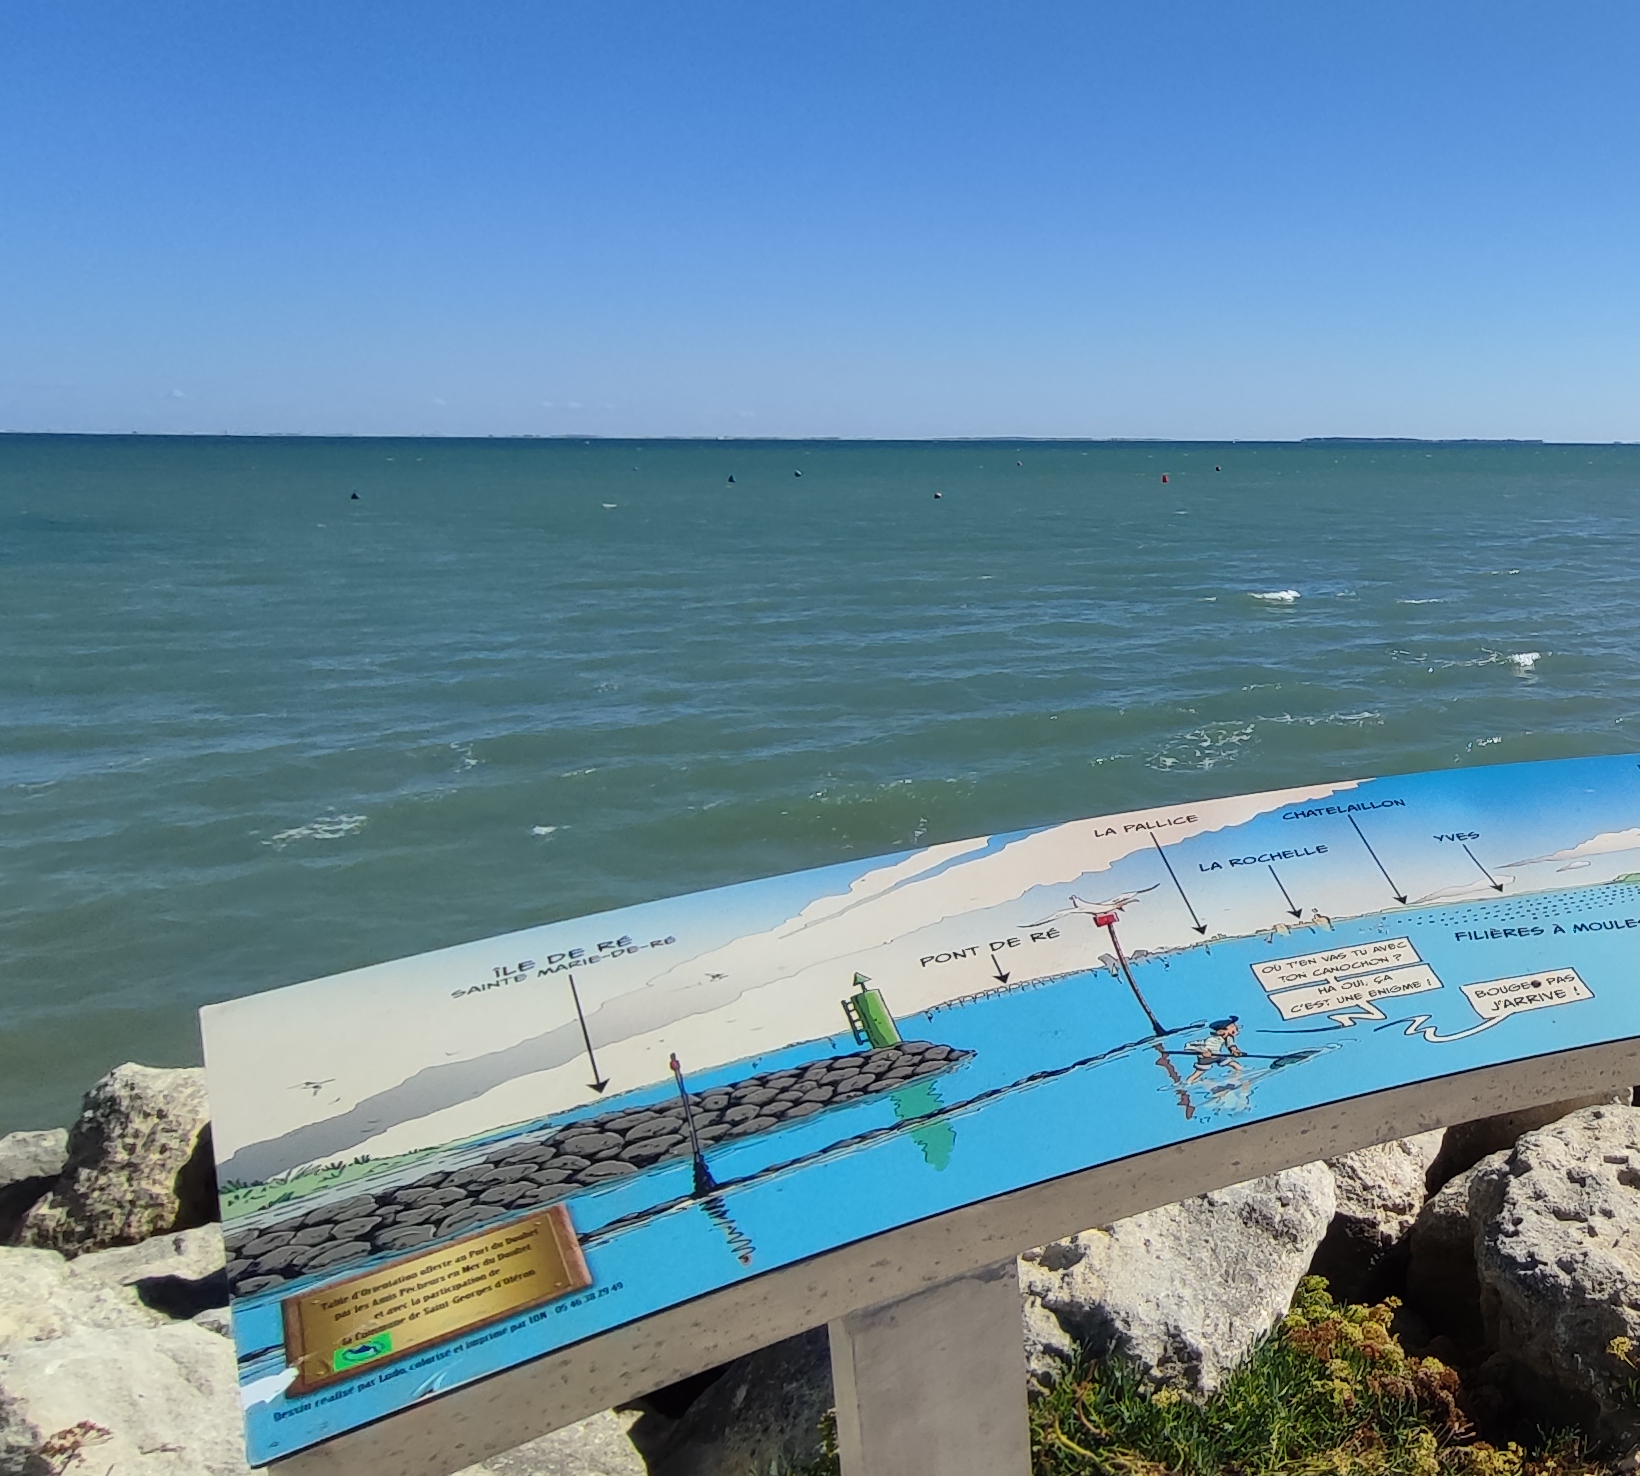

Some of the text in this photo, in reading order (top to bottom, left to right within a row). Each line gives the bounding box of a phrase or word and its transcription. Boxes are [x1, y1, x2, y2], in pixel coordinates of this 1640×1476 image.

[1282, 798, 1406, 820] CHATELAILLON
[1094, 813, 1199, 838] LA PALLICE
[1432, 831, 1480, 843] YVES
[1199, 844, 1329, 873] LA ROCHELLE
[1454, 925, 1545, 942] FILIÈRES
[1552, 923, 1566, 935] À
[492, 934, 633, 979] ÎLE DE RÉ
[919, 928, 1061, 968] PONT DE RÉ
[1286, 957, 1317, 969] T'EN
[1321, 952, 1347, 963] VAS
[1350, 948, 1368, 958] TU
[1373, 941, 1408, 954] AVEC
[450, 936, 677, 999] SAINTE MARIE-DE-RÉ
[1278, 953, 1402, 983] TON CANOCHON ?
[1290, 999, 1331, 1014] C'EST
[1336, 992, 1363, 1004] UNE
[1368, 981, 1422, 998] ENIGME
[1317, 985, 1337, 995] HA
[1373, 974, 1393, 985] ÇA
[1475, 974, 1575, 999] BOUGE PAS
[1491, 986, 1580, 1011] J'ARRIVE !
[455, 1253, 467, 1263] au
[469, 1245, 490, 1259] Port
[491, 1240, 504, 1250] du
[333, 1307, 351, 1321] par
[354, 1301, 370, 1314] les
[372, 1291, 397, 1306] Amis
[447, 1269, 460, 1280] en
[462, 1261, 481, 1274] Mer
[483, 1256, 496, 1266] du
[373, 1267, 500, 1320] et avec la participation de
[409, 1311, 421, 1321] de
[424, 1300, 450, 1315] Saint
[452, 1284, 493, 1304] Georges
[273, 1402, 312, 1422] Dessin
[357, 1378, 376, 1393] par
[453, 1343, 464, 1353] et
[510, 1320, 527, 1333] par
[555, 1303, 568, 1314] 05
[570, 1297, 582, 1308] 46
[598, 1287, 610, 1298] 29
[610, 1281, 624, 1291] 49
